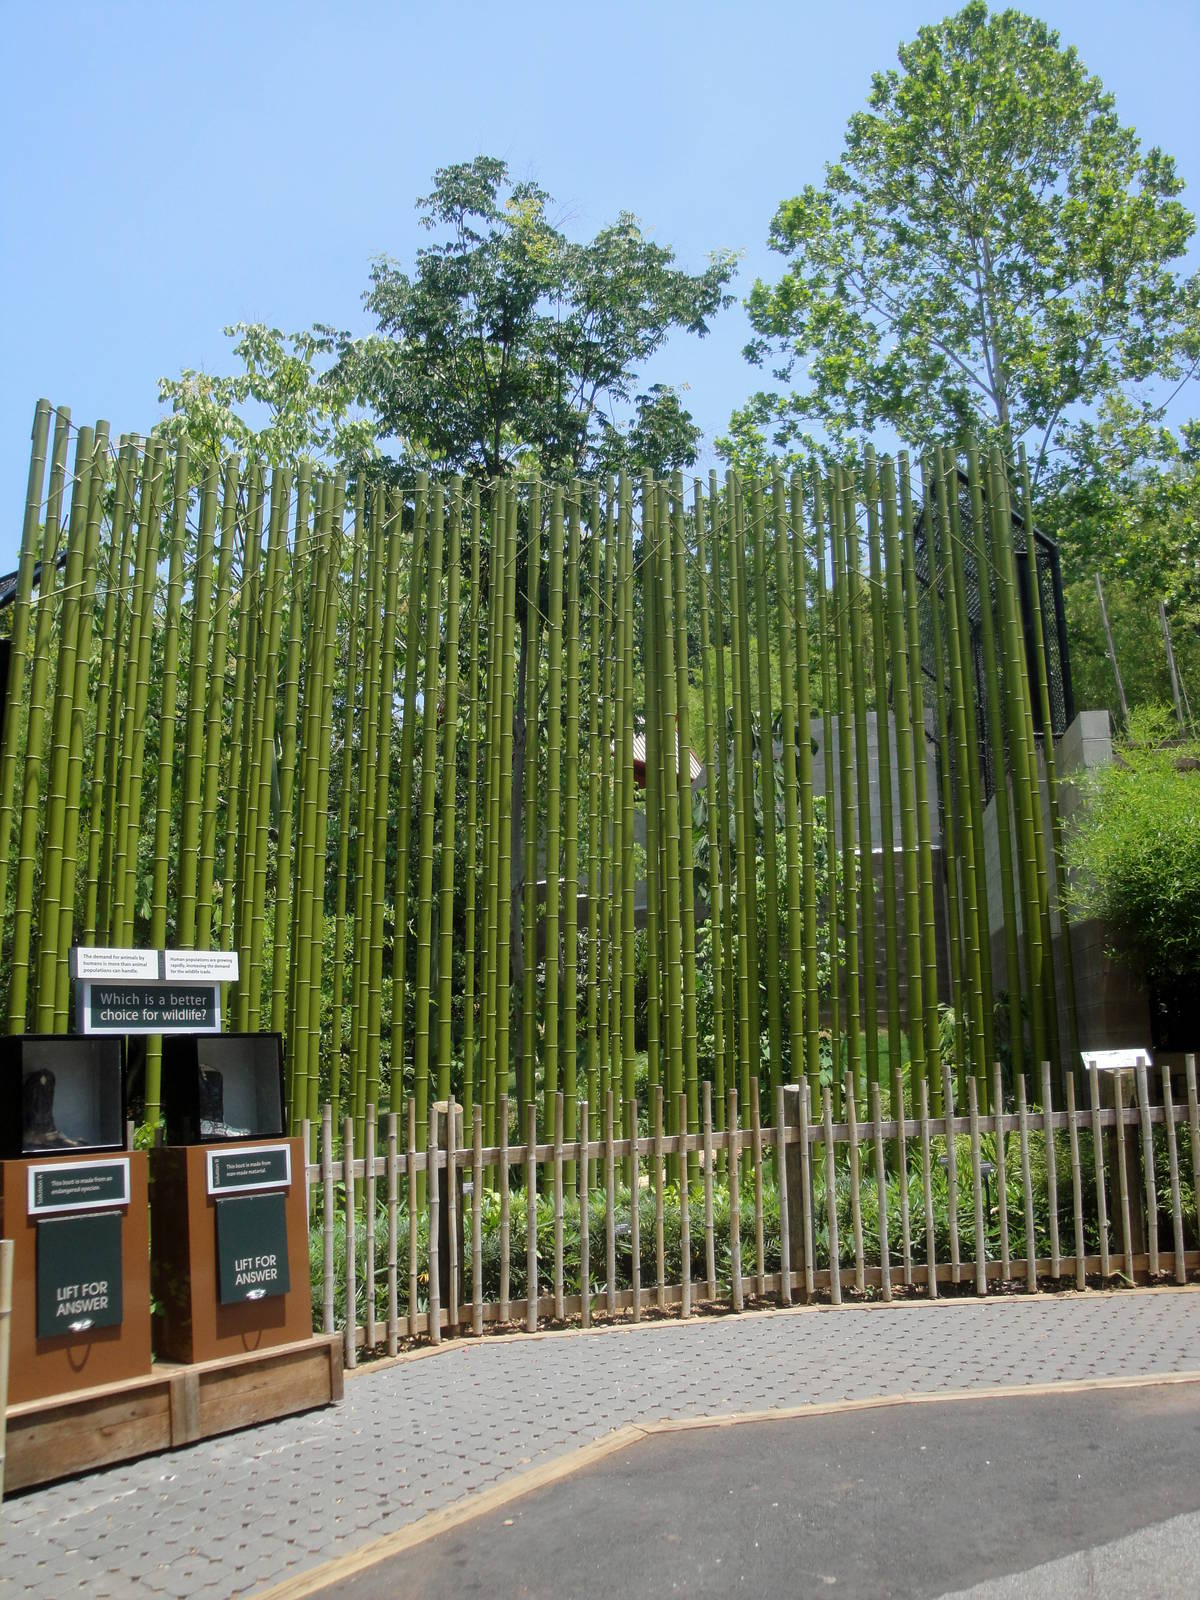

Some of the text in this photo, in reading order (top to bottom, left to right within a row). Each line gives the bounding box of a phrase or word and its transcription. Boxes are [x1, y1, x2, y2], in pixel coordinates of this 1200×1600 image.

[100, 993, 207, 1005] Which is a better
[100, 1008, 206, 1020] choice for wildlife?
[235, 1255, 276, 1271] LIFT FOR
[235, 1268, 277, 1285] ANSWER
[57, 1281, 108, 1301] LIFT FOR
[56, 1296, 109, 1317] ANSWER
